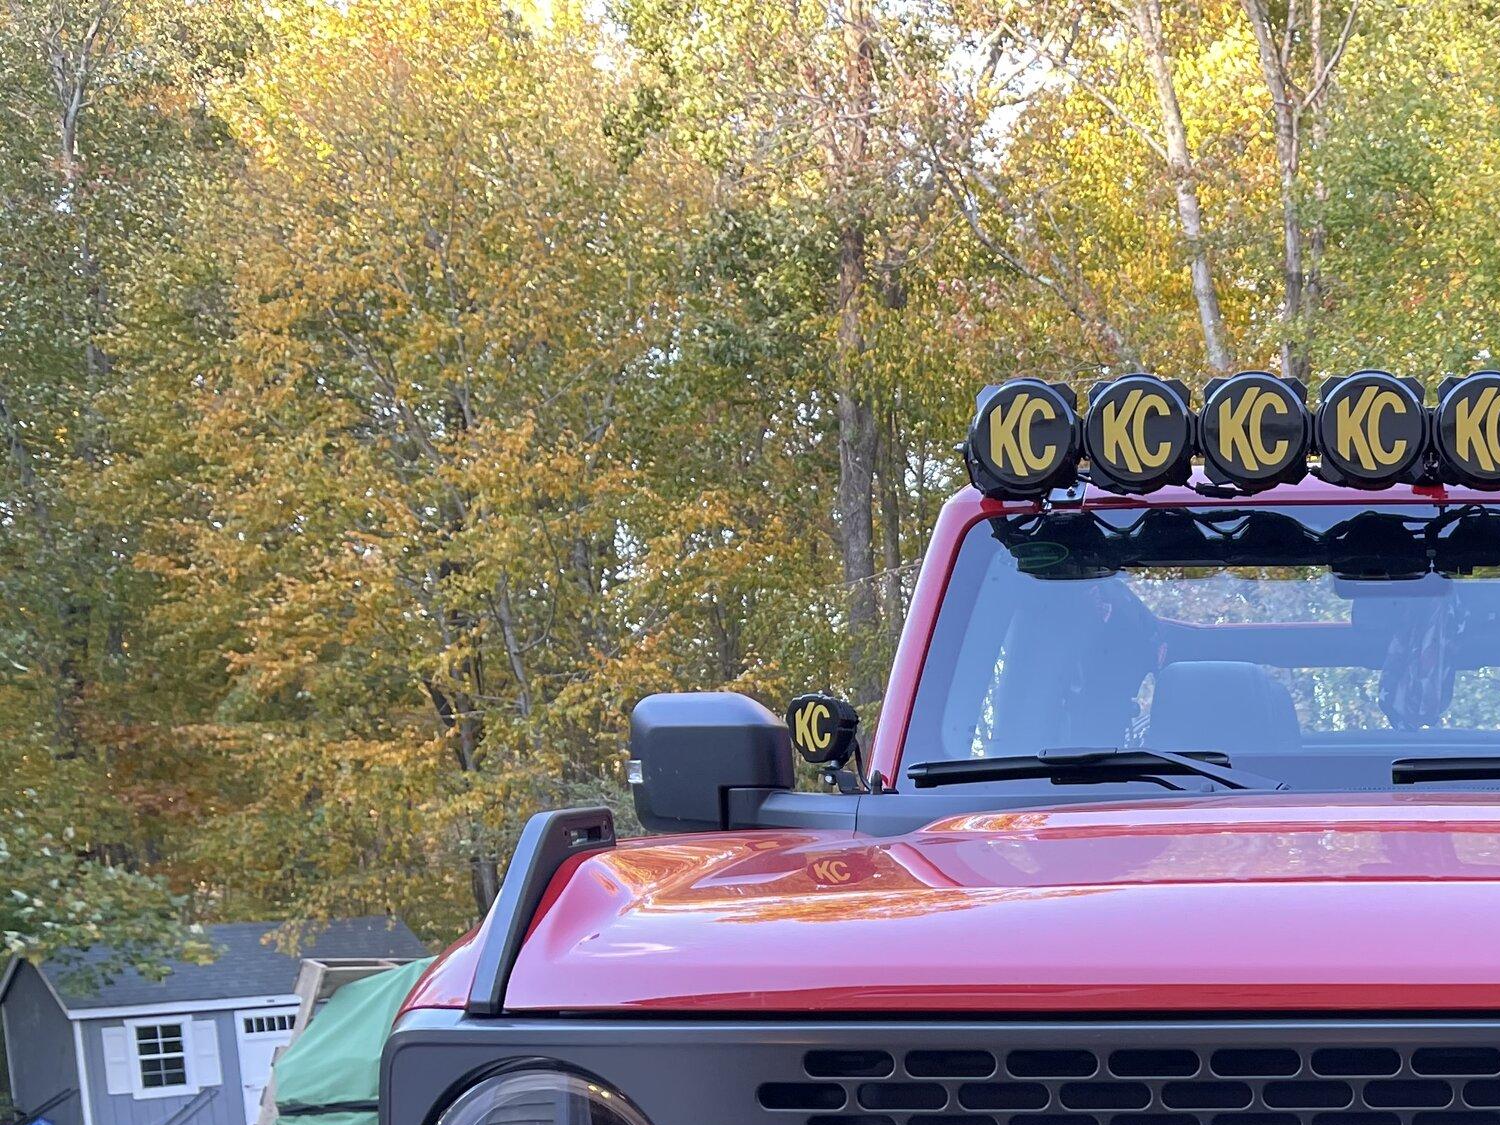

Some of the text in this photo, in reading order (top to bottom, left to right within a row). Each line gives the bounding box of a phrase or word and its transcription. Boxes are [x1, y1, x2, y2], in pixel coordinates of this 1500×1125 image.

[990, 393, 1056, 477] KC
[1102, 389, 1172, 474] KC
[1218, 386, 1289, 471] KC
[1336, 385, 1407, 471] KC
[795, 702, 831, 752] KC
